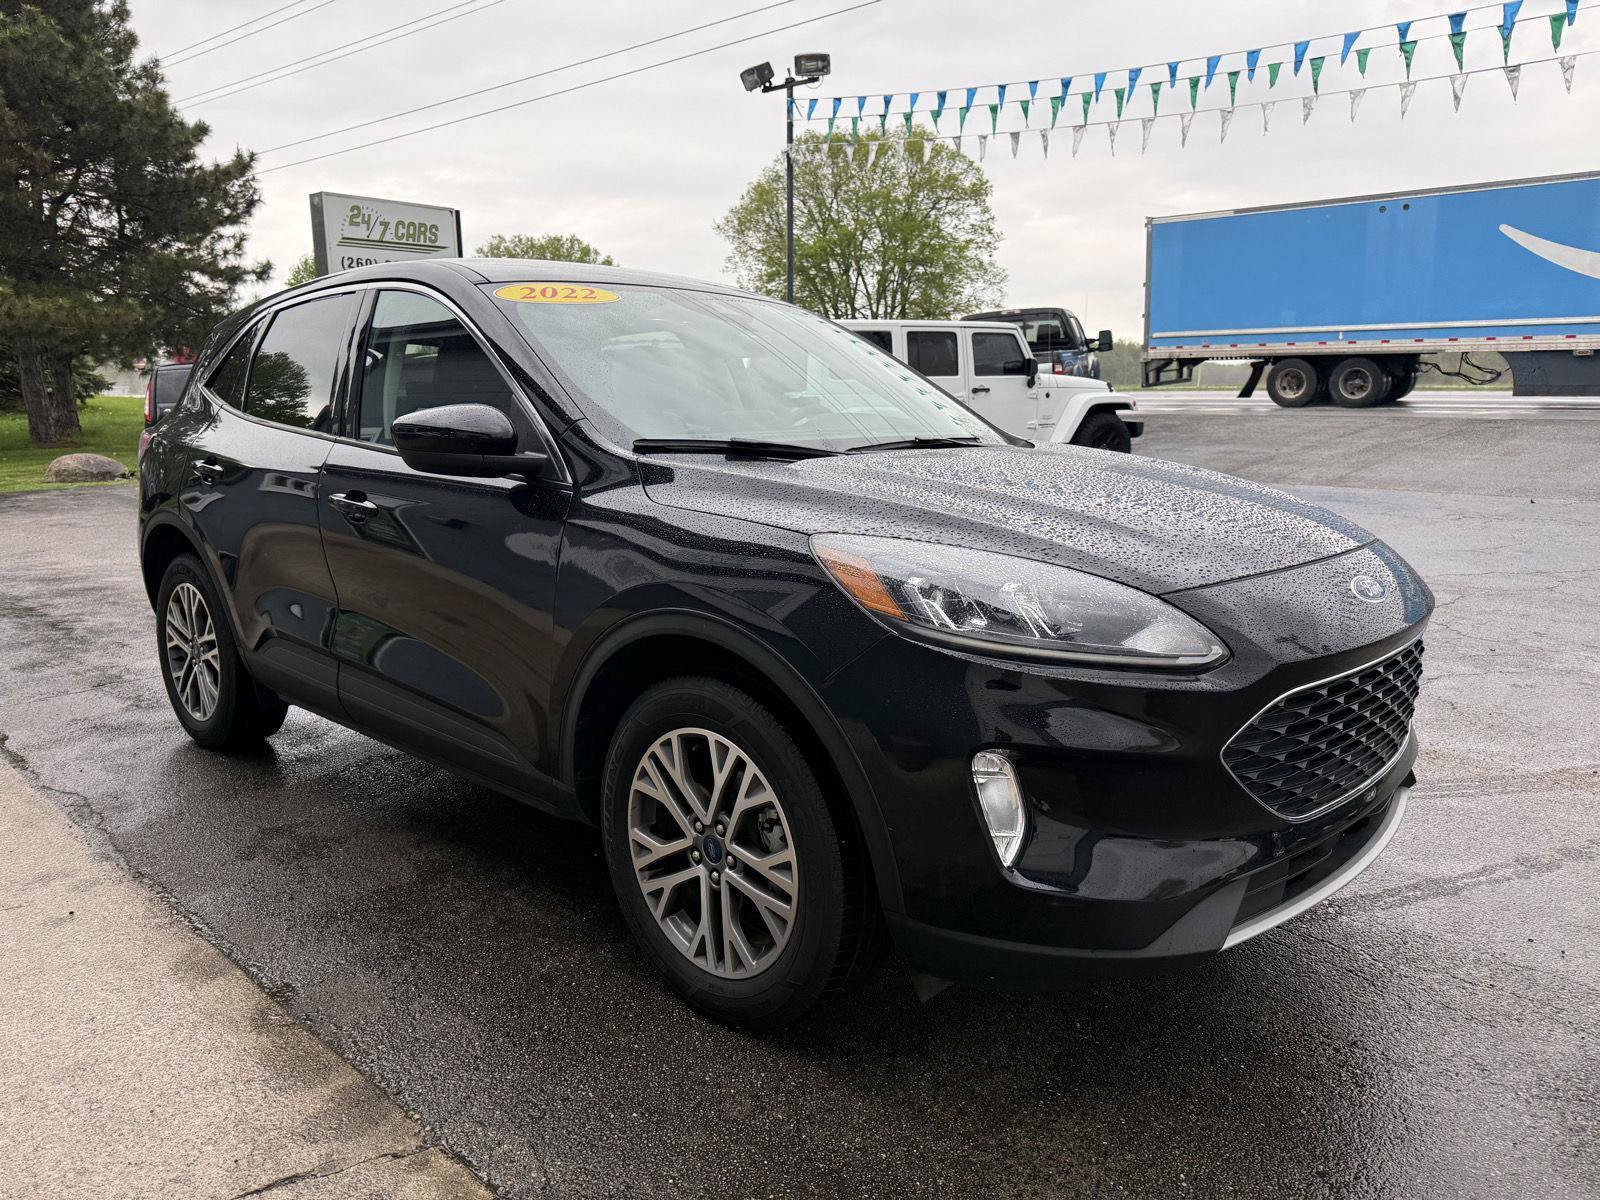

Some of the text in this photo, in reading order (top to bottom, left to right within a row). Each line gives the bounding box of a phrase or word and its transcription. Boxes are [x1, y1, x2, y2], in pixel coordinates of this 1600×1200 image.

[349, 204, 439, 244] 24/7 CARS
[519, 286, 598, 299] 2022
